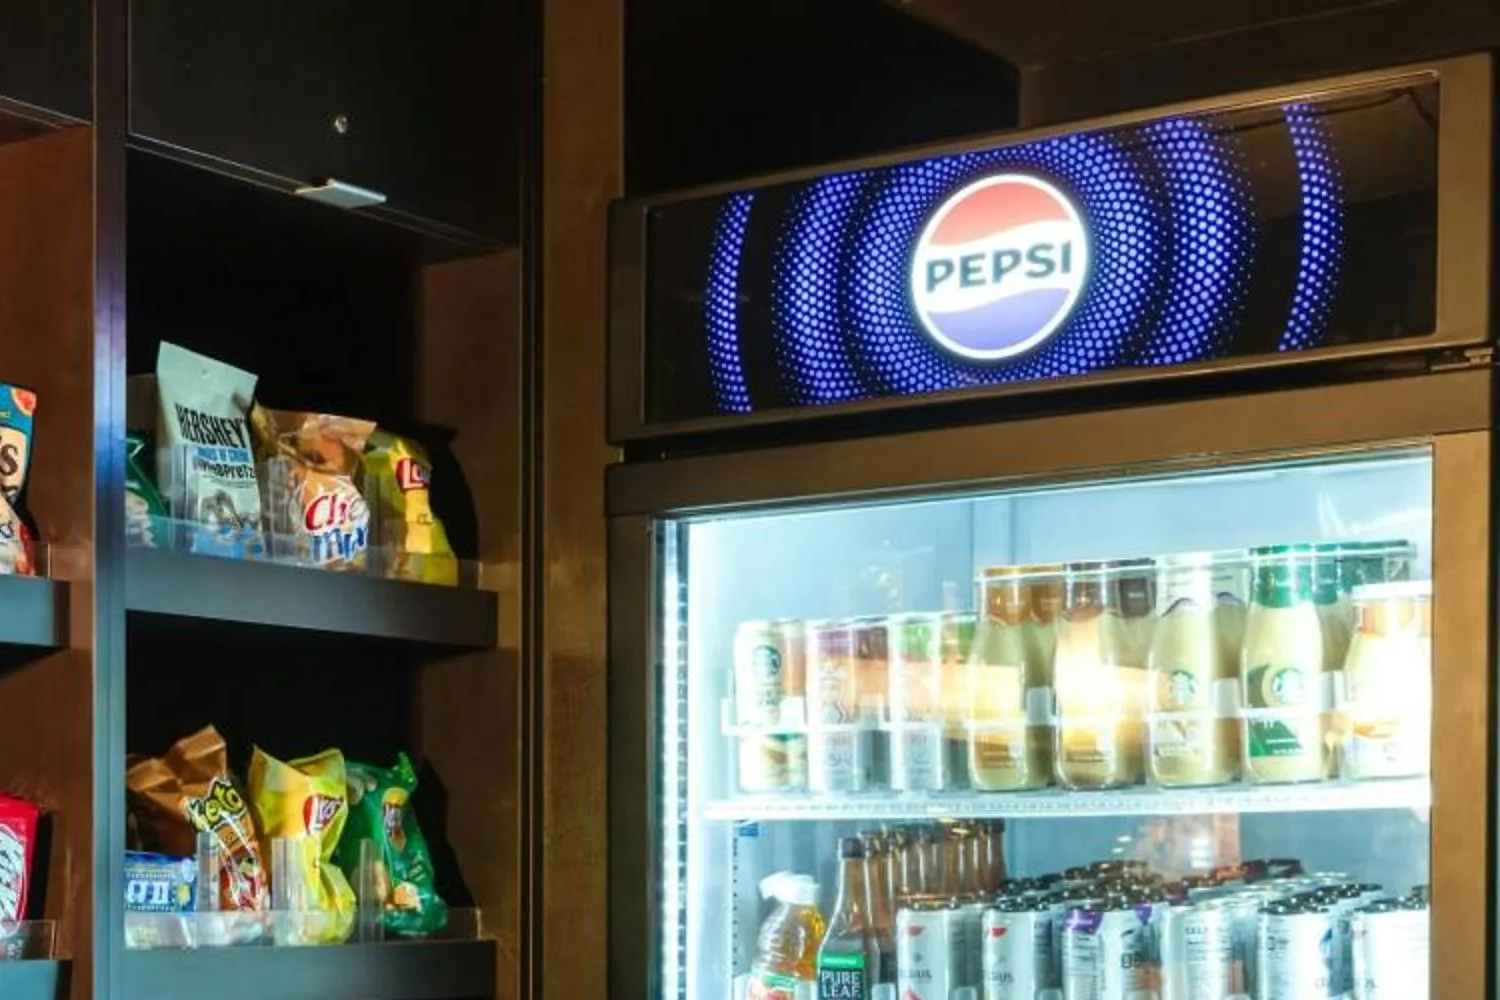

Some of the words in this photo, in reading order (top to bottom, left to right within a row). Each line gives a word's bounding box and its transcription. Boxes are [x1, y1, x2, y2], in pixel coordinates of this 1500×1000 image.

[925, 240, 1072, 293] PEPSI
[821, 970, 861, 985] PURE
[821, 984, 862, 999] LEAF
